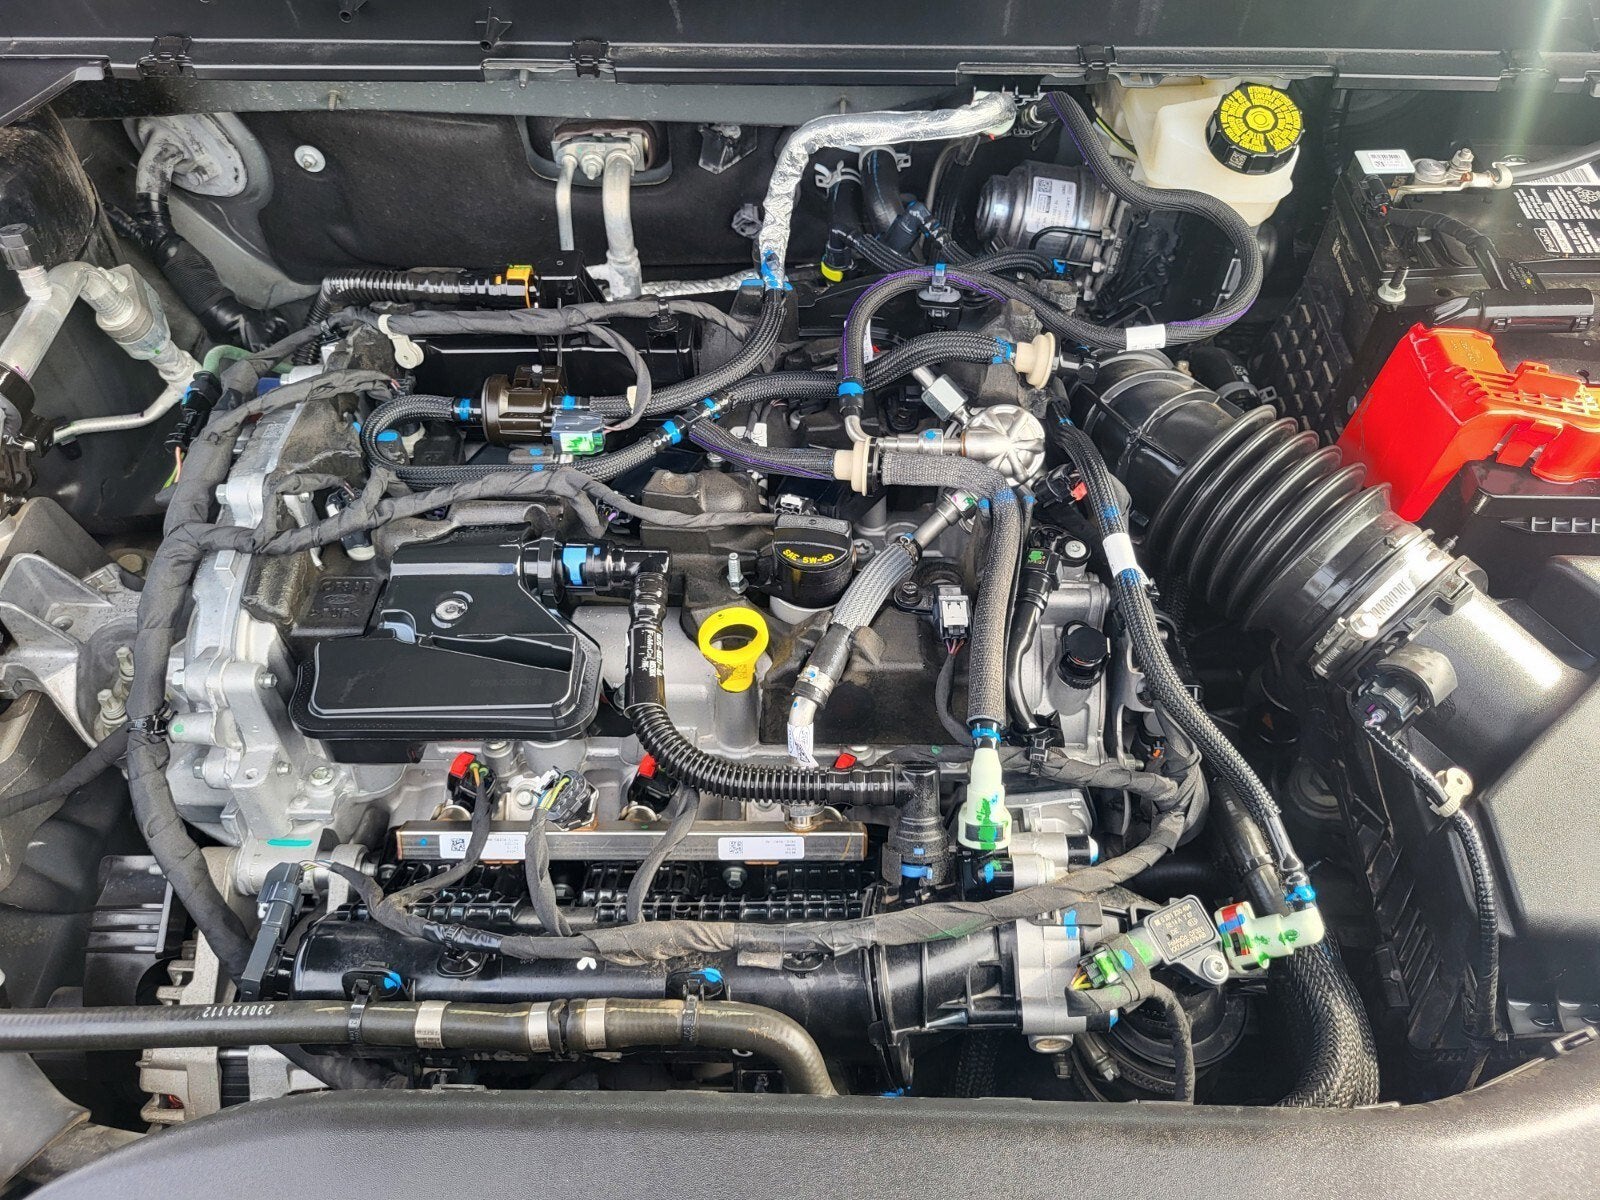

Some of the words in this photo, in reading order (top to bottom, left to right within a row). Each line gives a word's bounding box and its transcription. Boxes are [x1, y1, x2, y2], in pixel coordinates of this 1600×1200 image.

[782, 549, 800, 561] SAE
[802, 553, 835, 564] 5W-20
[202, 1003, 275, 1018] 230824112
